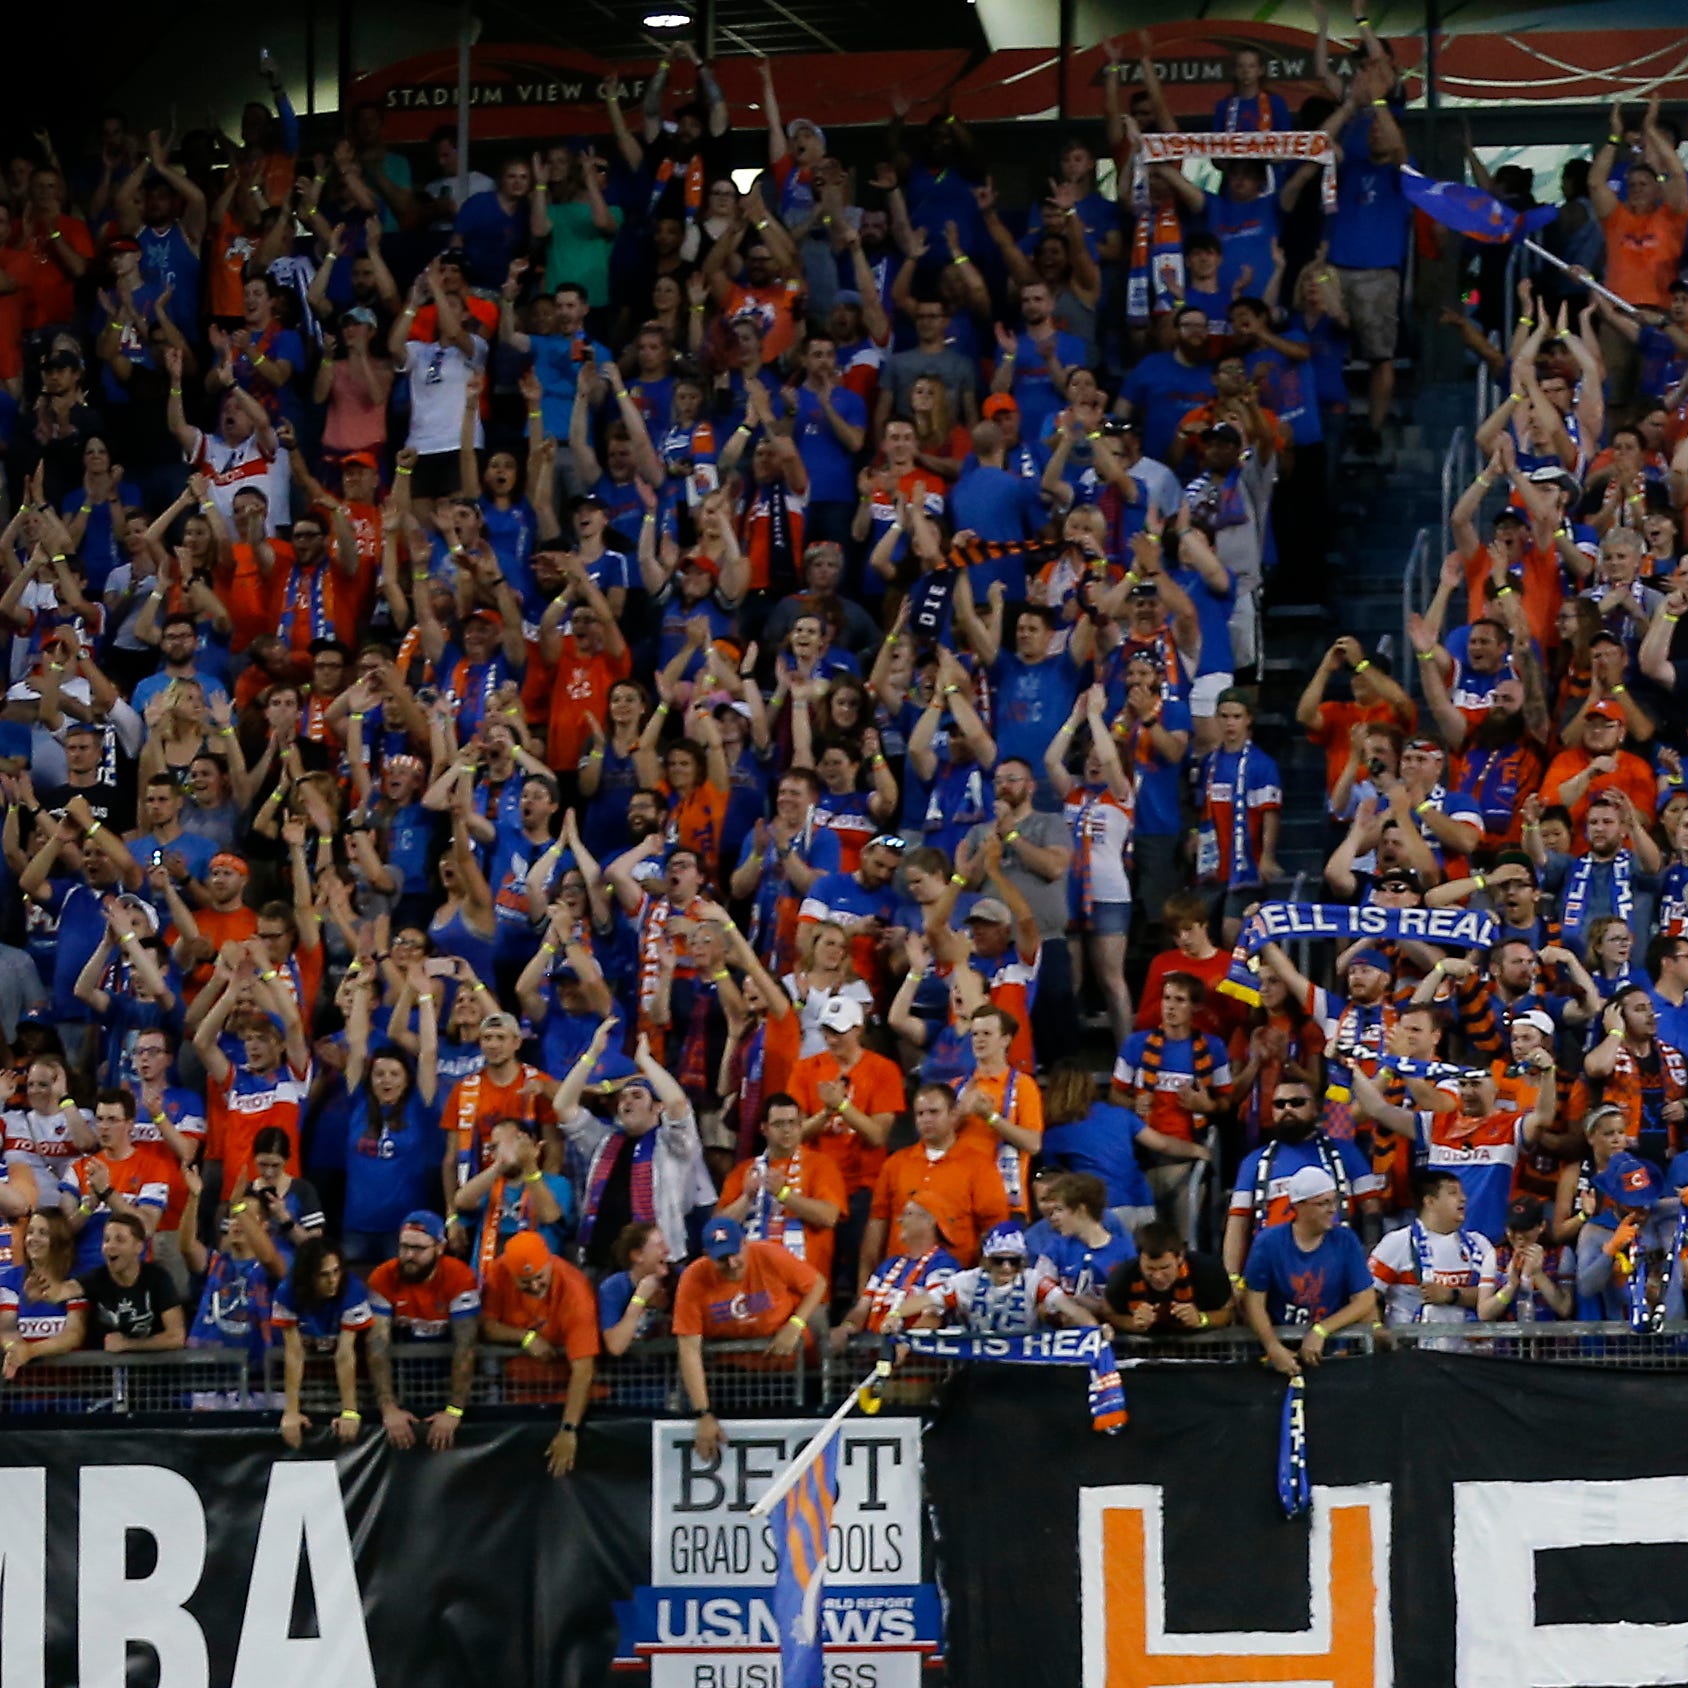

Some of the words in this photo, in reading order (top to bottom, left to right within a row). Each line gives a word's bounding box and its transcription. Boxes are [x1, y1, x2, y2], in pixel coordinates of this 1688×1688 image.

[516, 81, 583, 103] VIEW
[1143, 132, 1328, 161] LIONHEARTED
[1347, 905, 1387, 933] IS
[1398, 909, 1494, 948] REAL
[1023, 1328, 1101, 1357] REA
[672, 1438, 902, 1512] BET
[671, 1524, 751, 1574] GRAD
[762, 1523, 903, 1574] SOOLS
[855, 1597, 915, 1609] REPORT
